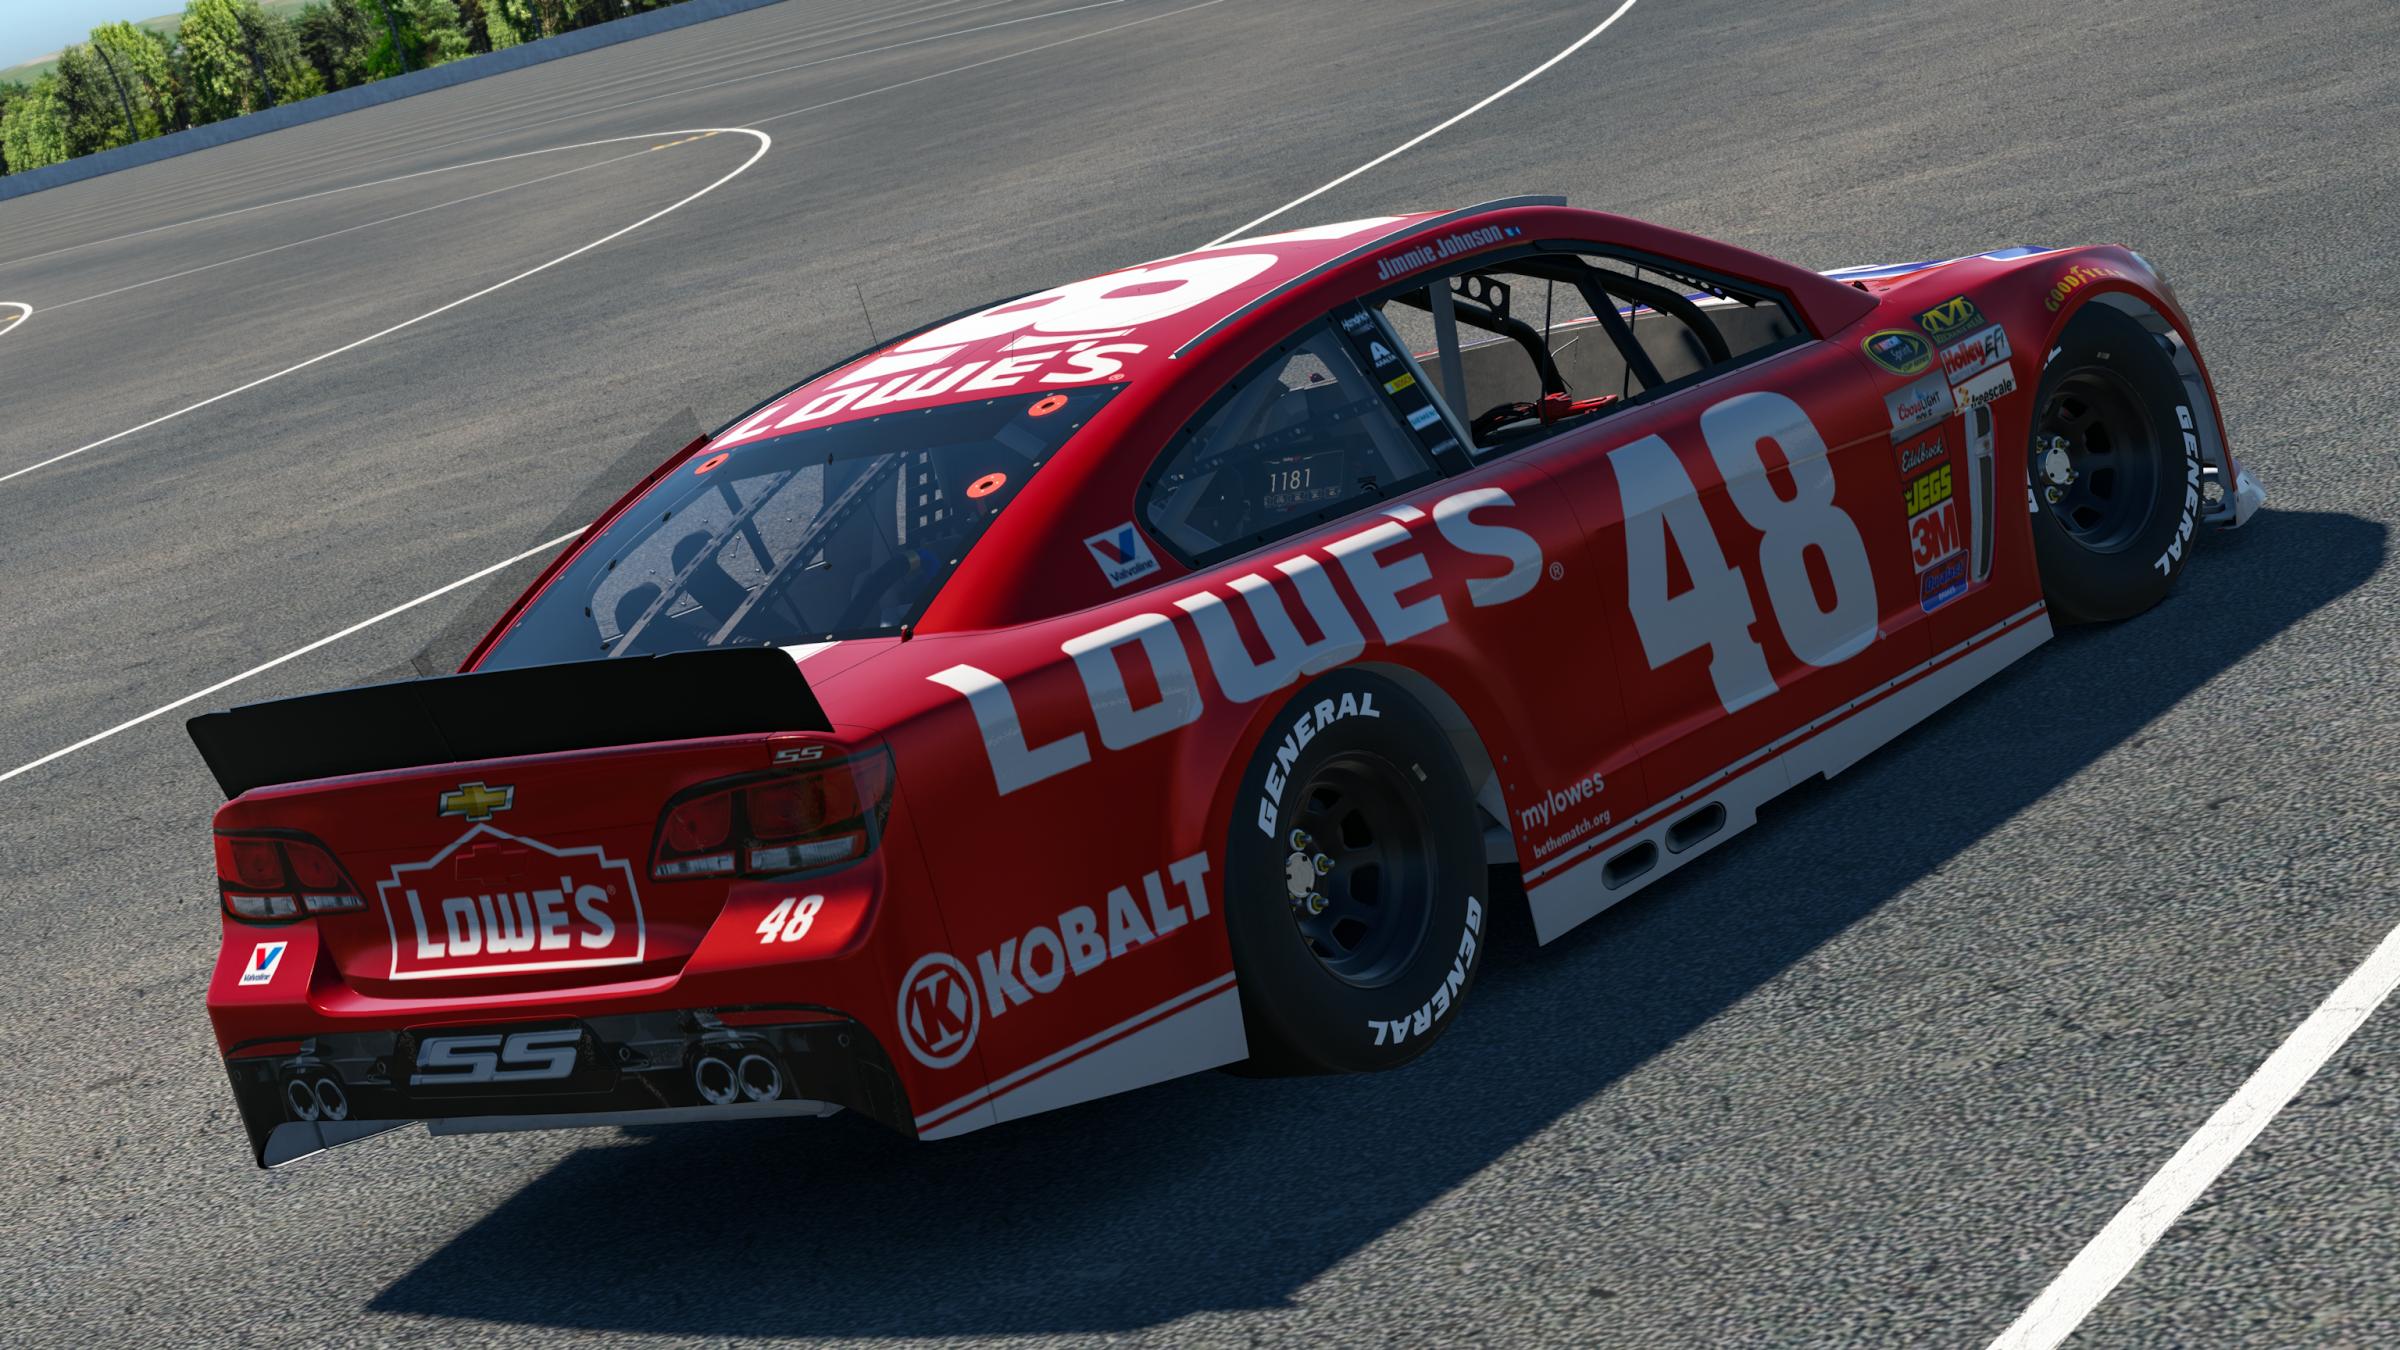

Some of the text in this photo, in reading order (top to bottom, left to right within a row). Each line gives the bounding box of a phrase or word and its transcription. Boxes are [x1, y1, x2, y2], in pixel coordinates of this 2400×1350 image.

[1377, 225, 1503, 280] Jimmie Johnson
[1942, 328, 2005, 373] Holley EFI
[709, 340, 1148, 450] LOWE'S
[1971, 379, 2013, 407] freescale
[1269, 468, 1311, 493] 1181
[1902, 436, 1943, 472] Edelbrock
[1907, 464, 1953, 517] JEGS
[2155, 405, 2200, 577] GENERAL
[1607, 391, 1879, 714] 48
[1912, 503, 1959, 567] 3M
[1110, 558, 1154, 582] Valvoline
[926, 487, 1543, 796] LOWE'S
[773, 745, 824, 764] SS
[1258, 692, 1381, 838] GENERAL
[1521, 772, 1605, 831] mylowes
[1533, 809, 1611, 859] bethematch.org
[406, 876, 616, 959] LOWE'S
[755, 894, 825, 945] 48
[976, 851, 1210, 1018] KOBALT
[1367, 896, 1482, 1046] GENERAL
[410, 1029, 582, 1086] SS
